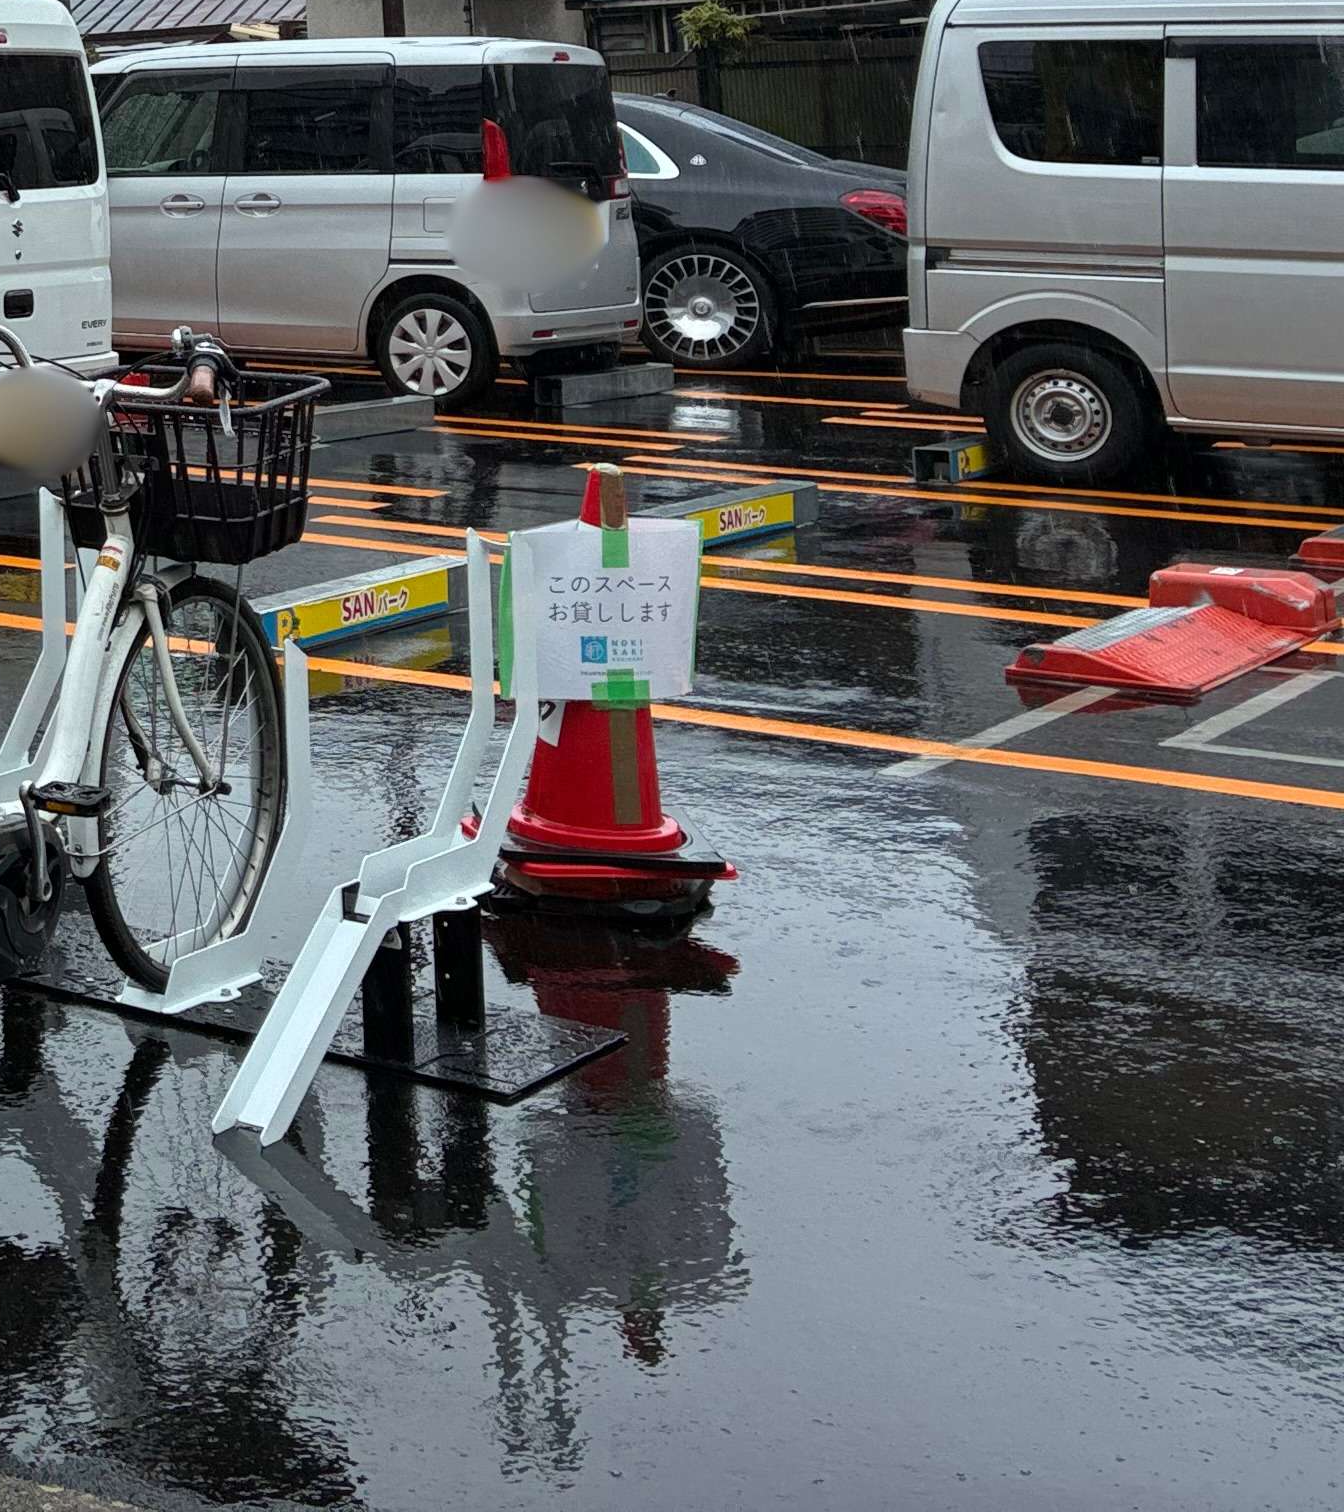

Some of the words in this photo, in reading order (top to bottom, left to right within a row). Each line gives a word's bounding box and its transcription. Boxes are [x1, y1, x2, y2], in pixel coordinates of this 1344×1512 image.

[81, 319, 107, 329] EVERY
[549, 575, 672, 594] このスペース
[548, 601, 672, 624] お貸しします
